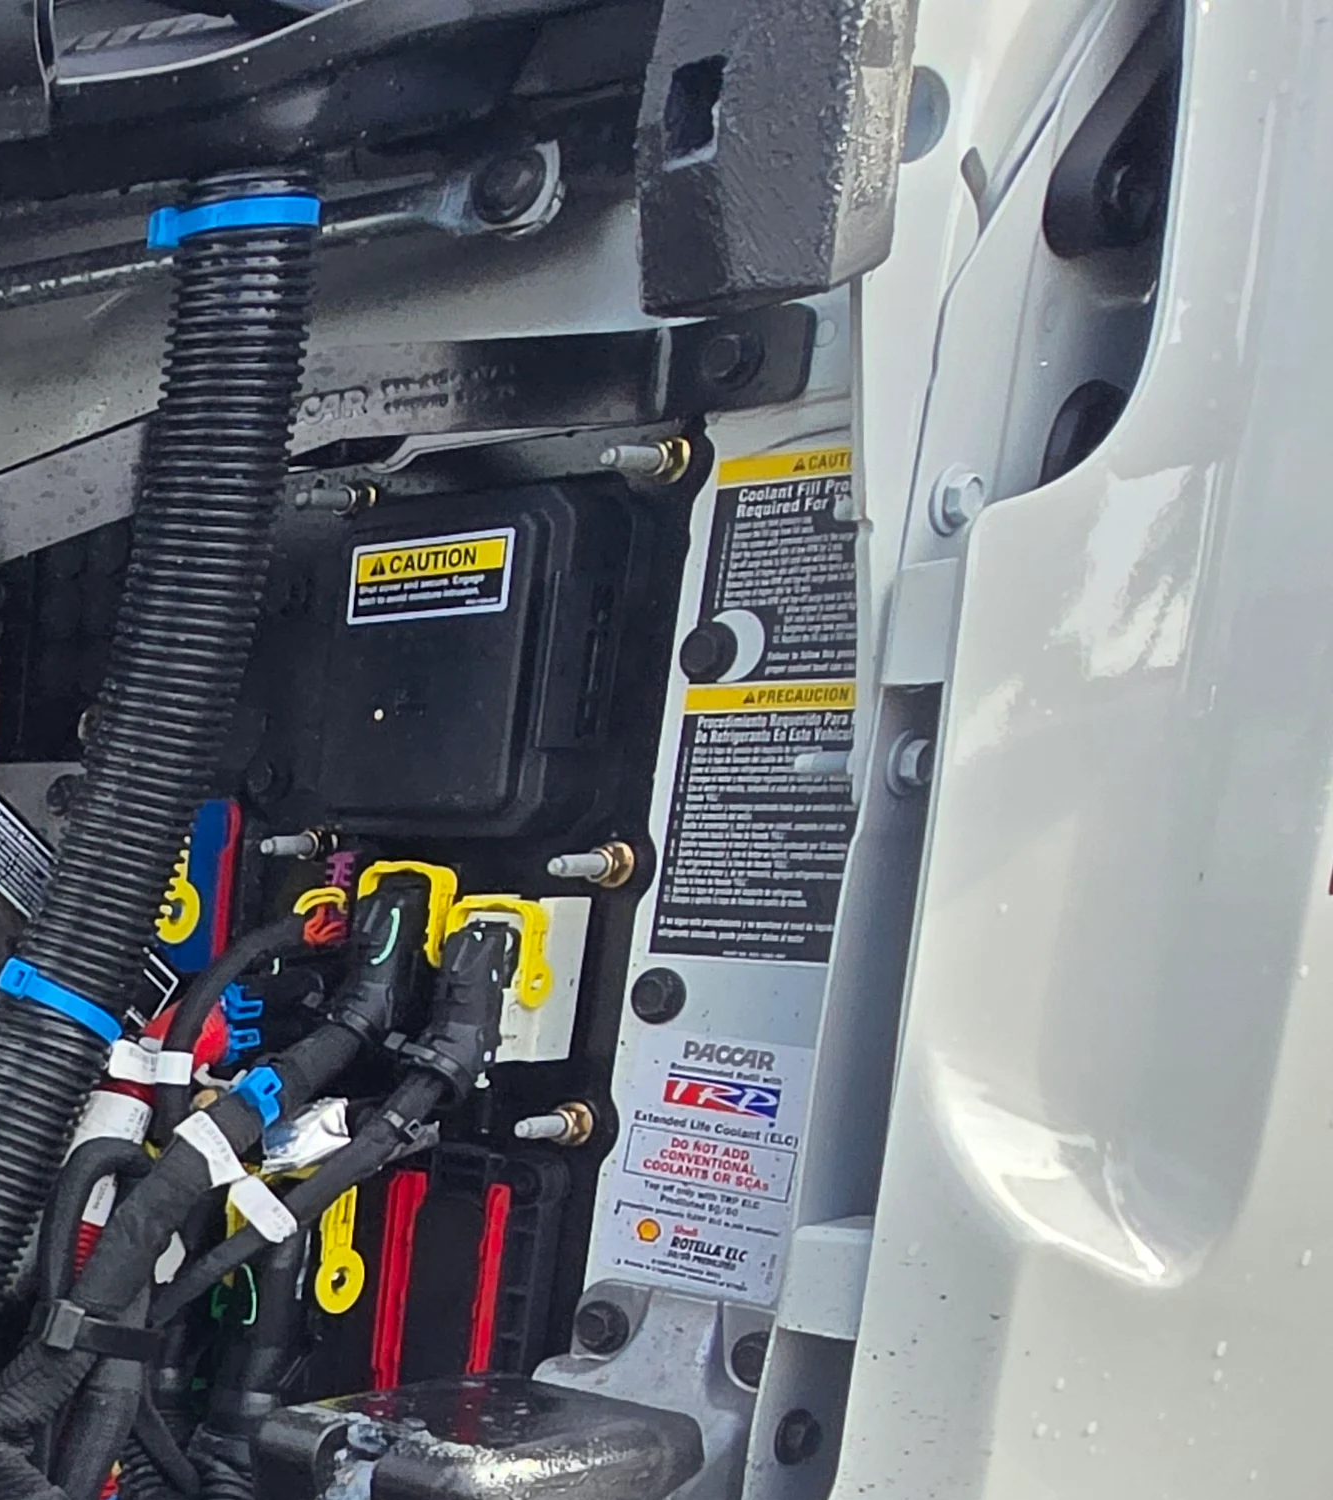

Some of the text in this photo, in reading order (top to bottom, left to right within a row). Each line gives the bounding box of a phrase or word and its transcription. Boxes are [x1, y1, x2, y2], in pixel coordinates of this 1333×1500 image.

[738, 485, 792, 503] Coolant
[797, 482, 819, 497] Fill
[736, 498, 829, 518] Required For
[390, 547, 477, 574] CAUTION
[757, 687, 850, 704] PRECAUCION
[683, 1040, 776, 1071] PACCAR
[671, 1080, 778, 1112] TRP
[634, 1110, 799, 1149] Extended Life Coolant (ELC)
[660, 1149, 757, 1176] CONVENTIONAL
[671, 1137, 750, 1161] DO NOT ADD
[643, 1159, 770, 1191] COOLANTS OR SCAs
[725, 1247, 748, 1263] ELC
